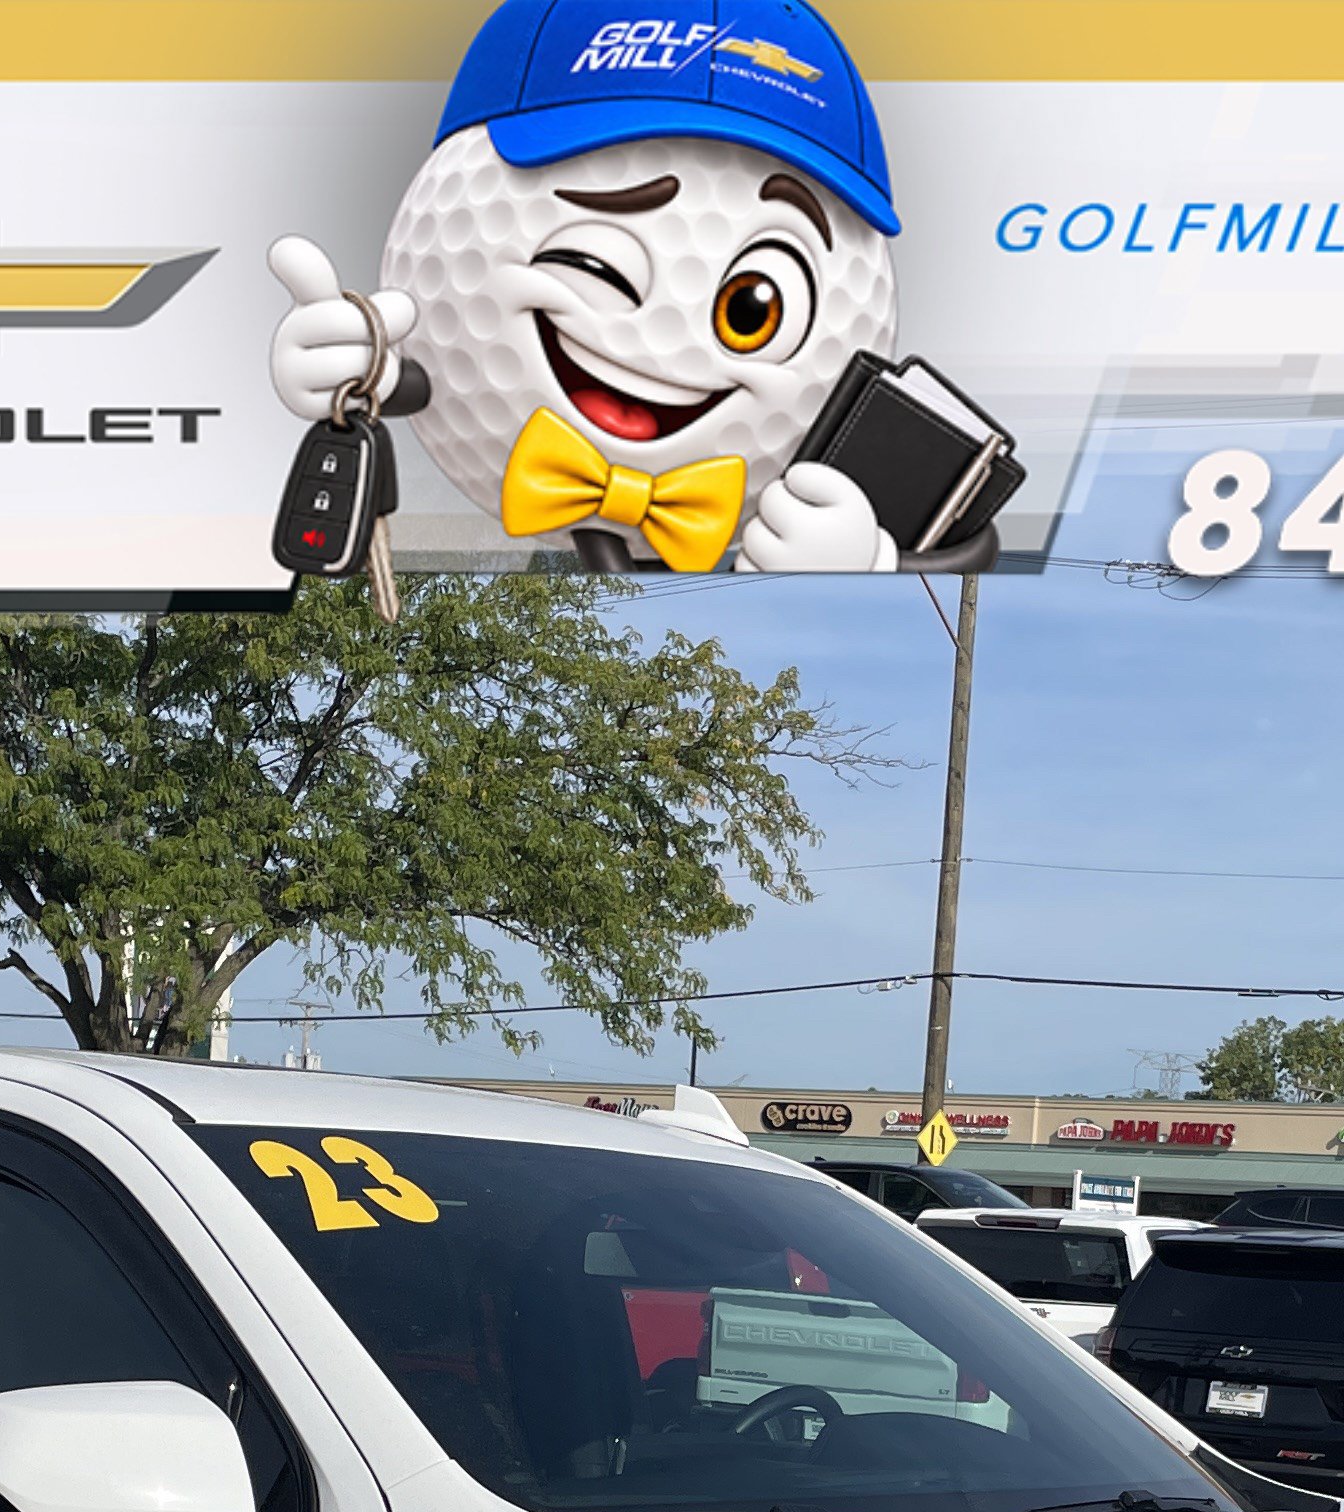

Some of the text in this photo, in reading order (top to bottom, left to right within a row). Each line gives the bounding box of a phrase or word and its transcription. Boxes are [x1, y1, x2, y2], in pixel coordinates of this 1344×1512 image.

[784, 1104, 847, 1122] crave
[1110, 1119, 1159, 1142] PAPA
[249, 1136, 439, 1231] 23
[722, 1322, 932, 1358] CHEVROLET
